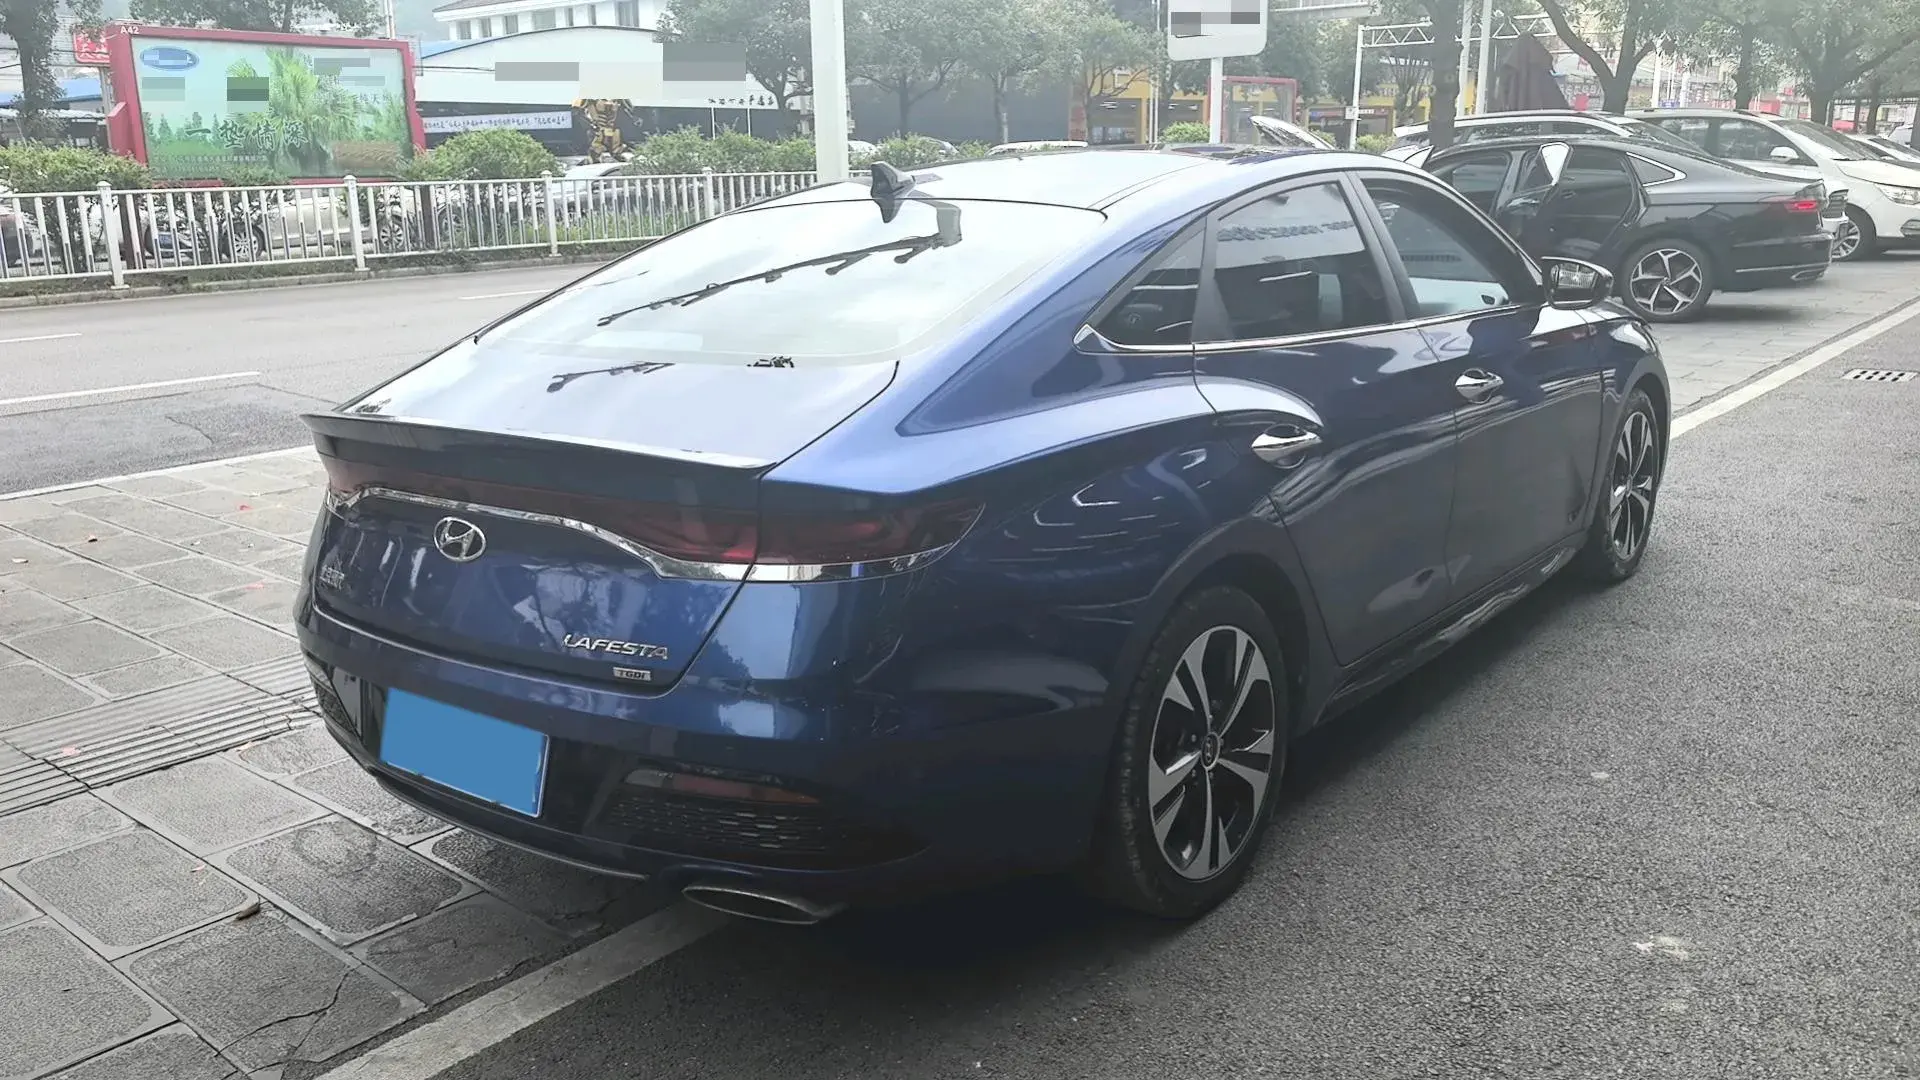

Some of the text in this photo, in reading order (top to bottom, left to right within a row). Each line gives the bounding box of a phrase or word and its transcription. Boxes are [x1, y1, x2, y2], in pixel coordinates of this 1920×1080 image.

[120, 26, 140, 35] A42
[184, 119, 308, 151] 一垫情深
[563, 634, 668, 660] LAFESTA
